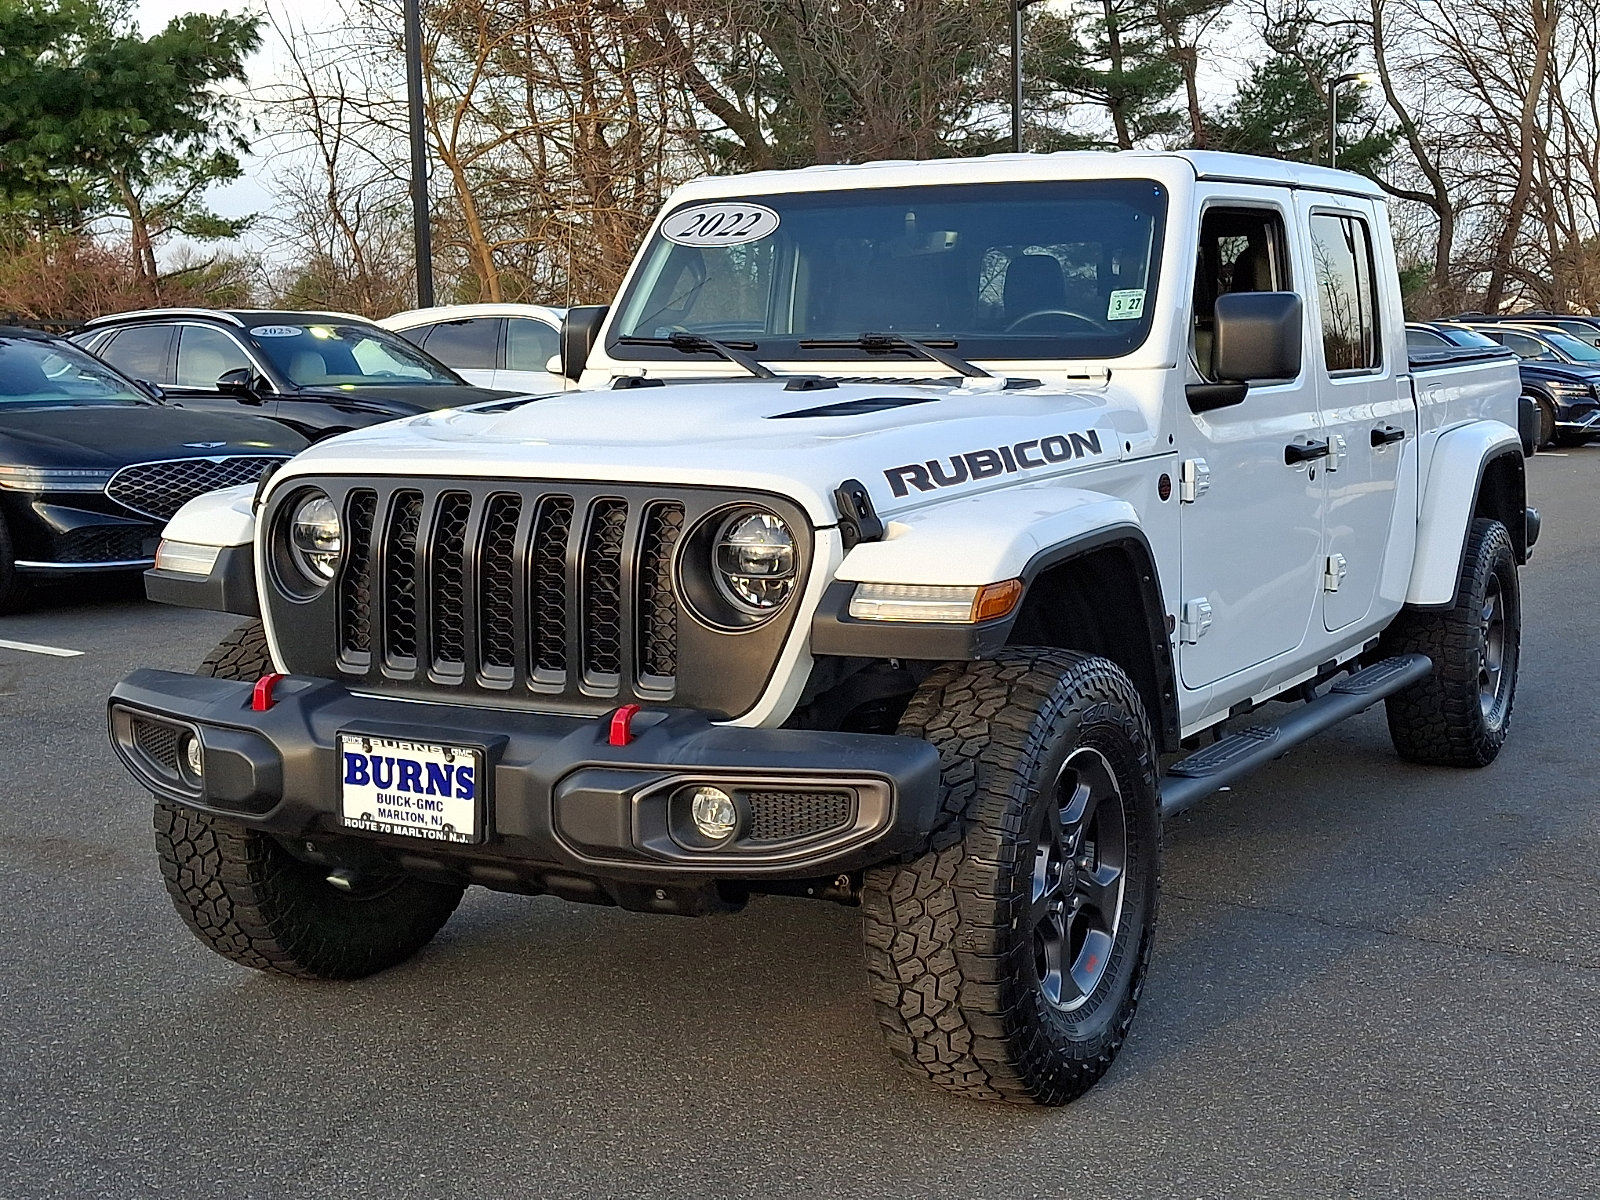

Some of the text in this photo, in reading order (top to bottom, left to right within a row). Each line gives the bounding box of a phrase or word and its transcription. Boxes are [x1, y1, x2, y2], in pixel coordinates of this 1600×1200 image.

[676, 212, 762, 237] 2022
[1115, 298, 1142, 311] 3 27
[883, 429, 1103, 498] RUBICON
[450, 748, 473, 758] GMC
[344, 752, 475, 800] BURNS
[376, 793, 444, 812] BUICK-GMC
[378, 808, 443, 826] MARLTON, NJ
[344, 818, 378, 831] ROUTE
[379, 823, 391, 833] 70
[449, 832, 469, 844] N.J.
